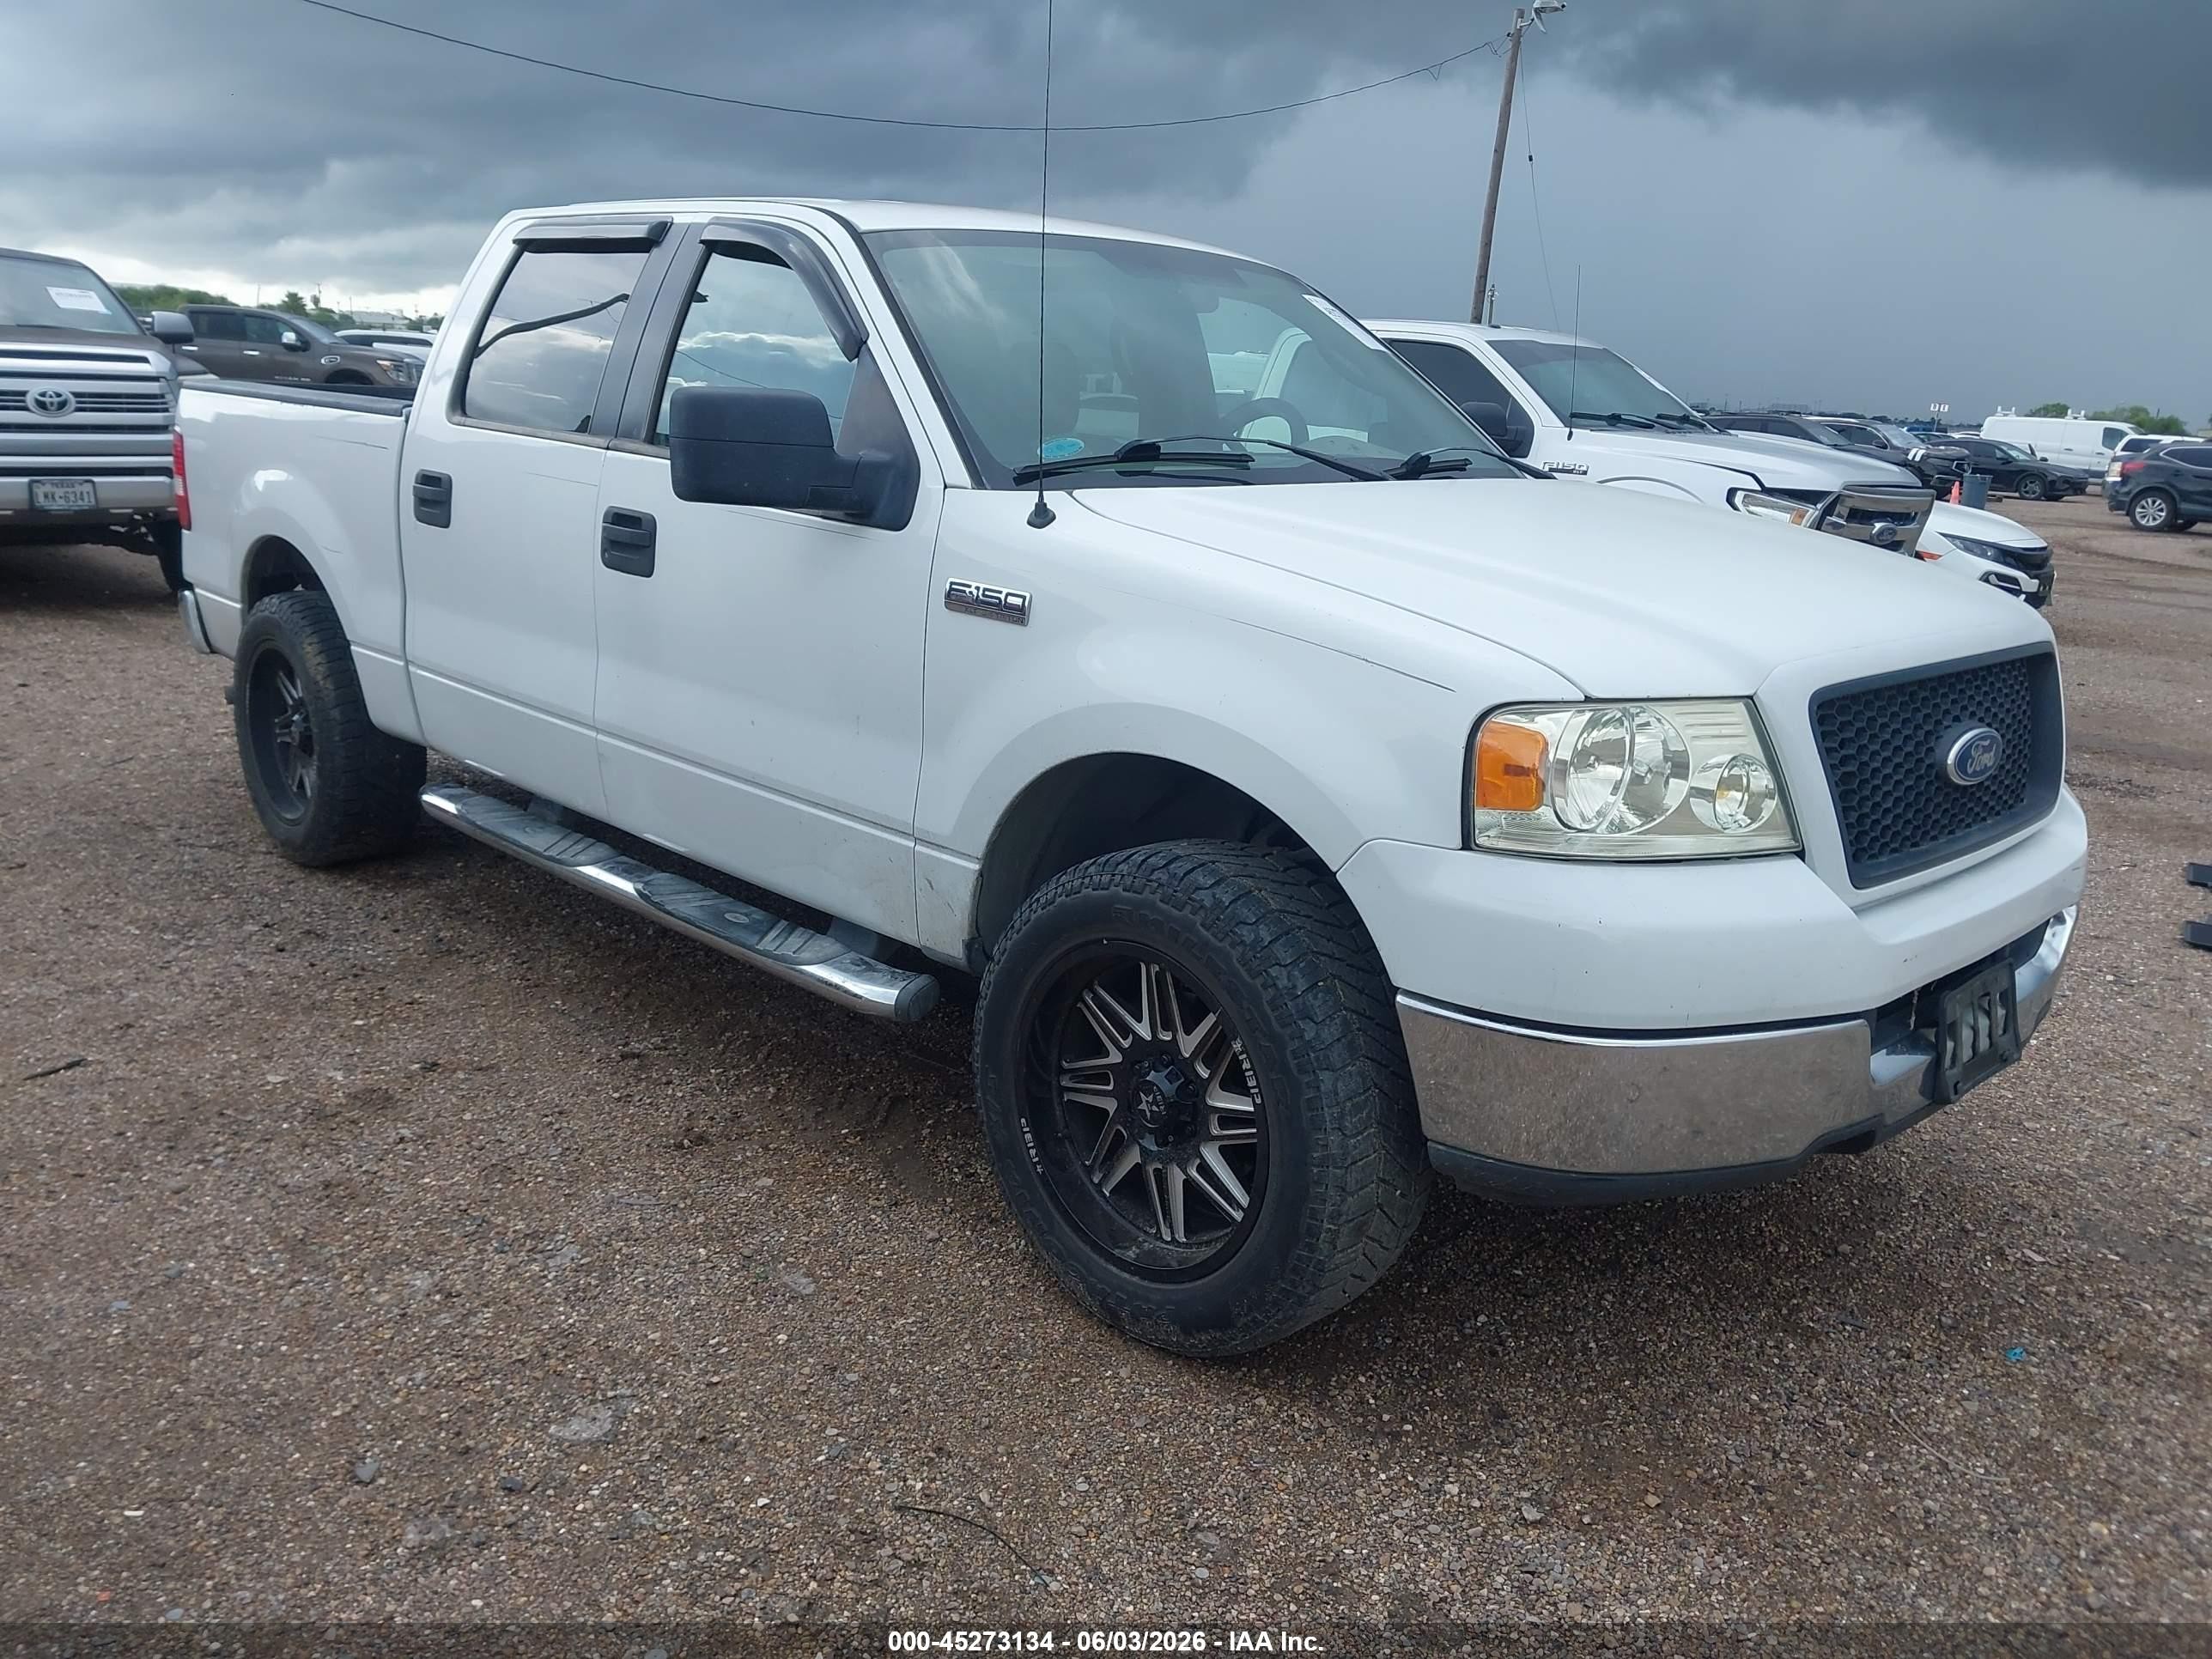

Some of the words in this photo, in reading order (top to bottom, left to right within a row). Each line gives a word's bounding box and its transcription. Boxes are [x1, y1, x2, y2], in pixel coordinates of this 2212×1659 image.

[1966, 738, 1996, 775] Ford
[1238, 1054, 1261, 1103] RBP
[1020, 1118, 1039, 1163] RBP
